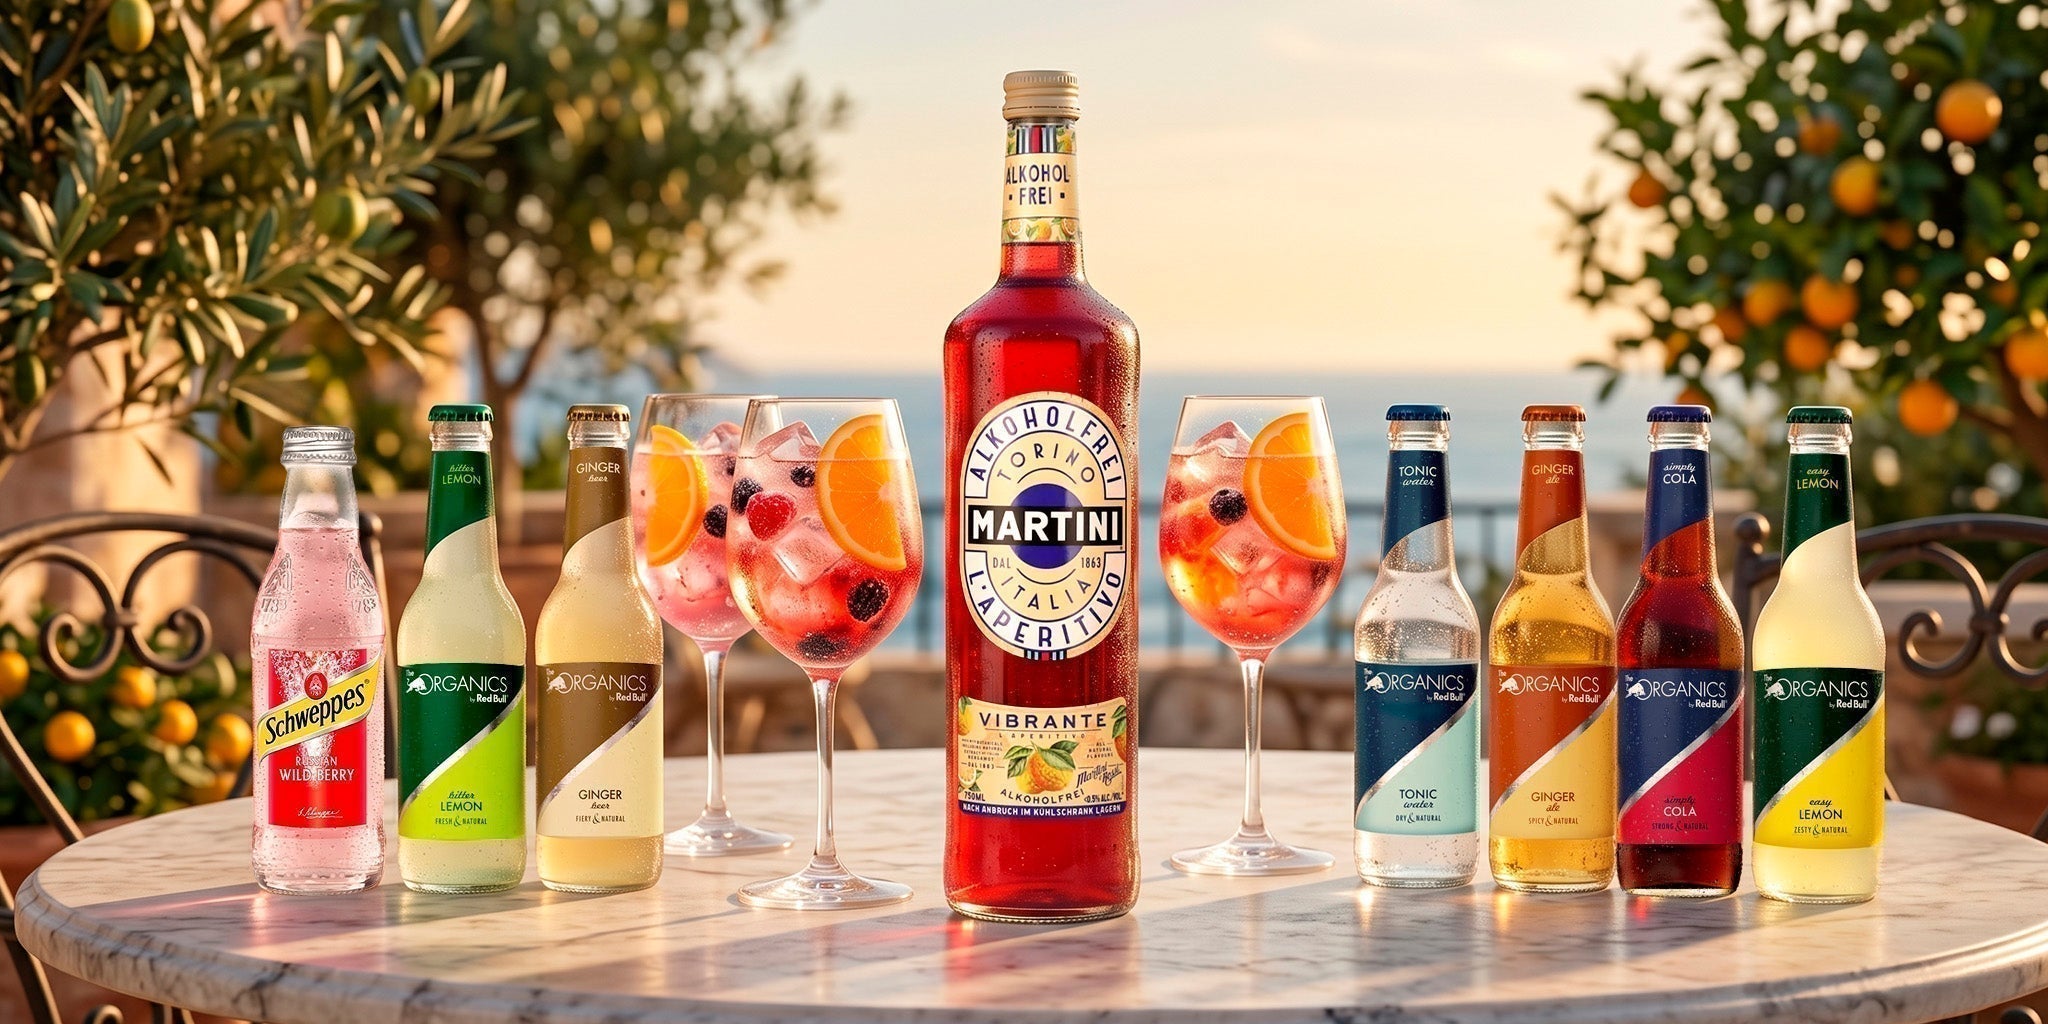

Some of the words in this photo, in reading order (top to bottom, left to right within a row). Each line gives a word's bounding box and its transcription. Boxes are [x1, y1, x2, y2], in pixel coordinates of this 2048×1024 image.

[1019, 186, 1053, 205] FREI
[969, 406, 1122, 484] ALKOHOLFREI
[448, 463, 475, 473] bitter
[576, 462, 620, 474] GINGER
[997, 443, 1095, 483] TORINO
[1663, 462, 1696, 473] simply
[1399, 466, 1437, 477] TONIC
[1531, 463, 1574, 475] GINGER
[442, 474, 481, 485] LEMON
[587, 474, 608, 482] beer
[1402, 477, 1434, 486] water
[1545, 475, 1560, 484] ale
[1663, 473, 1697, 484] COLA
[1796, 478, 1839, 490] LEMON
[972, 510, 1119, 542] MARTINI
[993, 557, 1011, 568] DAL
[1081, 556, 1102, 568] 1863
[1001, 576, 1091, 610] ITALIA
[557, 672, 647, 694] ORGANICS
[1374, 672, 1465, 694] ORGANICS
[1625, 674, 1634, 682] The
[1764, 674, 1773, 682] The
[417, 673, 508, 695] ORGANICS
[1509, 673, 1600, 695] ORGANICS
[1635, 678, 1727, 700] ORGANICS
[1774, 678, 1868, 701] ORGANICS
[476, 694, 492, 703] Red
[493, 694, 507, 703] Bull
[616, 692, 632, 701] Red
[632, 692, 646, 702] Bull
[1433, 692, 1449, 701] Red
[1450, 692, 1464, 702] Bull
[1568, 693, 1585, 703] Red
[1585, 694, 1599, 703] Bull
[1695, 699, 1711, 708] Red
[1712, 699, 1726, 709] Bull
[1836, 699, 1853, 708] Red
[1853, 699, 1868, 709] Bull
[265, 683, 365, 745] Schweppes
[979, 712, 1107, 729] VIBRANTE
[295, 757, 338, 766] RUSSIAN
[279, 768, 312, 781] WILD
[317, 768, 355, 781] BERRY
[448, 790, 475, 799] bitter
[578, 789, 622, 800] GINGER
[964, 790, 986, 802] 750ML
[1000, 788, 1085, 804] ALKOHOLFREI
[1399, 788, 1437, 799] TONIC
[1531, 792, 1575, 802] GINGER
[440, 802, 482, 811] LEMON
[590, 801, 610, 809] beer
[1403, 800, 1434, 809] water
[1546, 802, 1561, 812] ale
[1809, 799, 1832, 808] easy
[962, 802, 980, 813] NACH
[981, 805, 1018, 816] ANBRUCH
[1021, 807, 1031, 816] IM
[1033, 805, 1094, 817] KÜHLSCHRANK
[1095, 803, 1122, 815] LAGERN
[1663, 806, 1697, 817] COLA
[1799, 809, 1843, 820] LEMON
[435, 816, 453, 825] FRESH
[453, 815, 462, 827] &
[462, 817, 487, 825] NATURAL
[575, 815, 592, 823] FIERY
[592, 813, 600, 824] &
[601, 815, 626, 823] NATURAL
[1407, 813, 1415, 824] &
[1528, 817, 1545, 825] SPICY
[1545, 815, 1553, 827] &
[1553, 817, 1579, 825] NATURAL
[1652, 822, 1674, 831] STRONG
[1683, 822, 1709, 831] NATURAL
[1794, 826, 1812, 834] ZESTY
[1812, 824, 1821, 837] &
[1821, 826, 1848, 834] NATURAL
